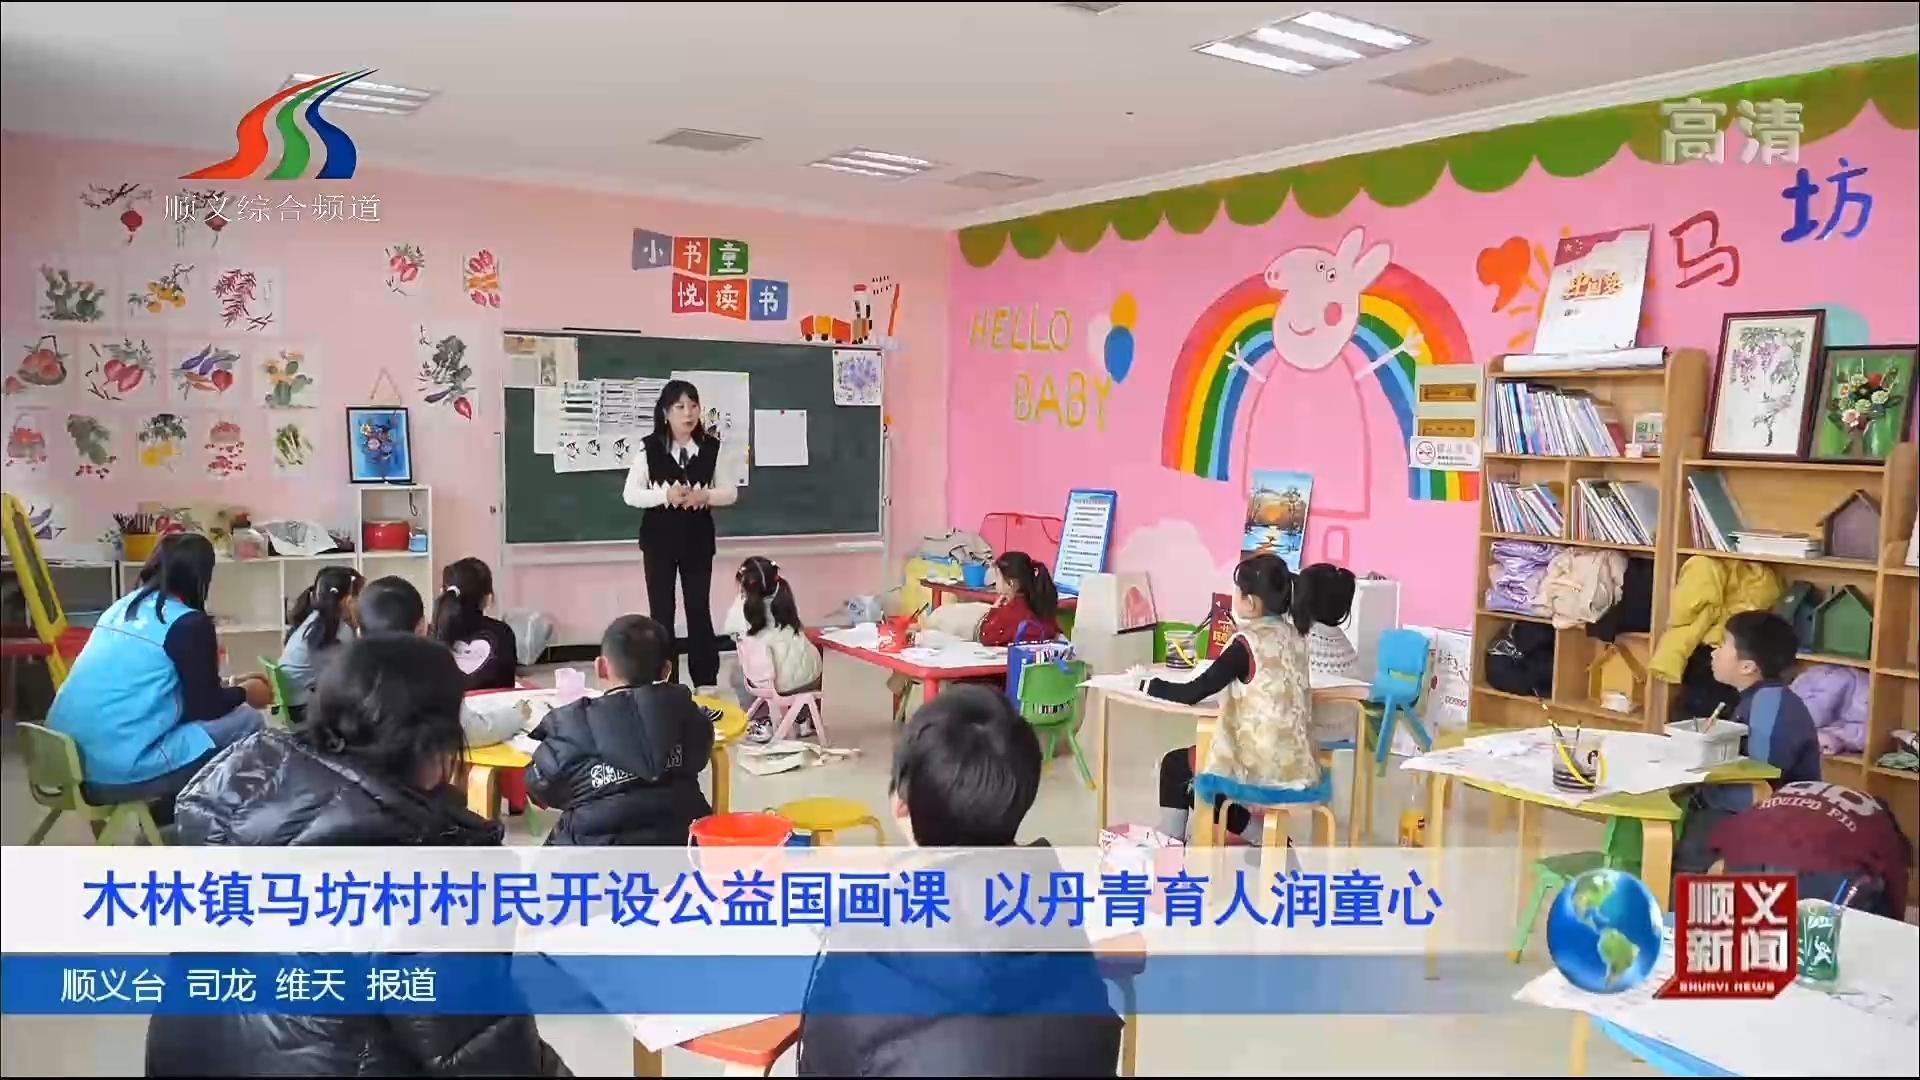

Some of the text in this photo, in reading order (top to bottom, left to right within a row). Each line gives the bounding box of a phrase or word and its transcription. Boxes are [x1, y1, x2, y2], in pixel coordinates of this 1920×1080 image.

[643, 240, 744, 273] 小书童
[678, 281, 779, 316] 悦读书
[970, 303, 1073, 352] HELLO
[1015, 369, 1112, 432] BABY
